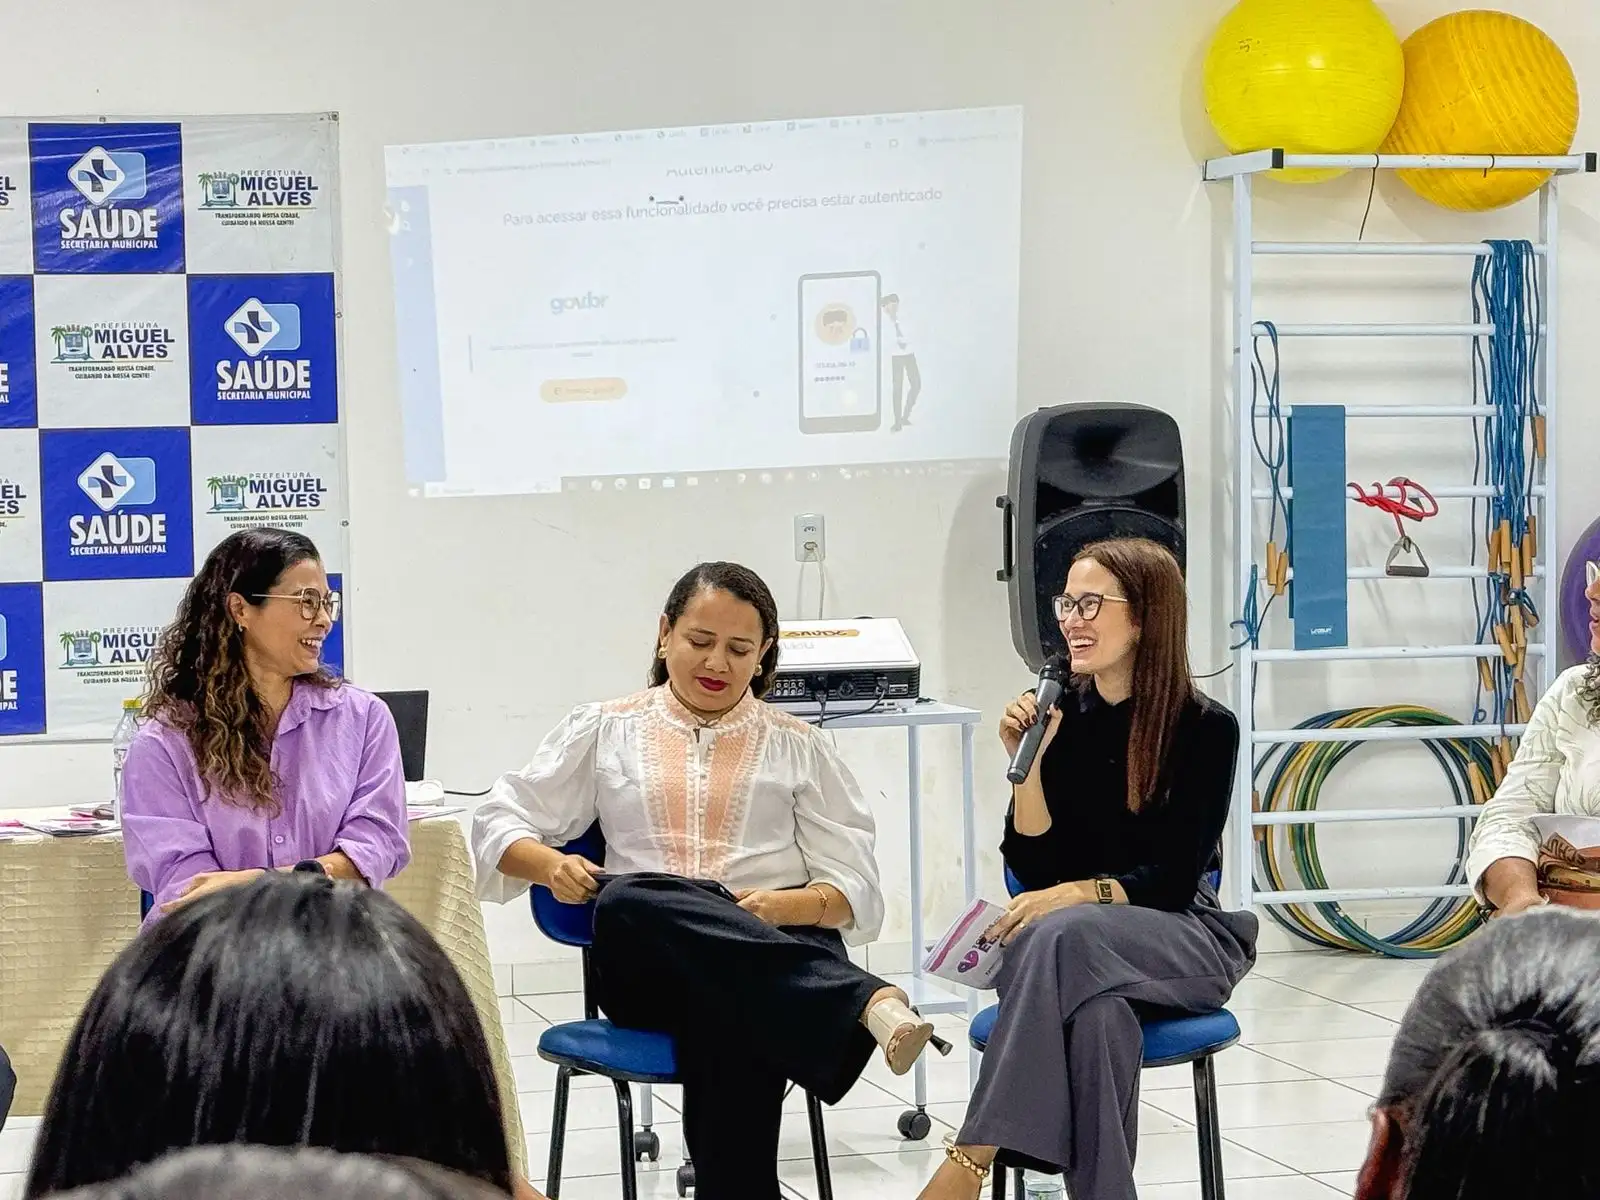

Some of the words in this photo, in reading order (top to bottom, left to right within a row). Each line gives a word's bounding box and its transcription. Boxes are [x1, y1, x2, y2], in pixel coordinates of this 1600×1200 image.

[240, 176, 318, 191] MIGUEL
[247, 192, 312, 206] ALVES
[503, 213, 533, 226] Para
[536, 210, 588, 223] acessar
[592, 207, 622, 221] essa
[626, 200, 728, 219] funcionalidade
[731, 198, 764, 213] você
[767, 193, 817, 212] precisa
[821, 193, 856, 207] estar
[859, 188, 943, 205] autenticado
[60, 203, 158, 239] SAÚDE
[61, 240, 110, 249] SECRETARIA
[112, 240, 158, 249] MUNICIPAL
[94, 329, 175, 343] MIGUEL
[102, 344, 168, 359] ALVES
[216, 355, 311, 390] SAÚDE
[217, 391, 264, 400] SECRETARIA
[266, 390, 311, 399] MUNICIPAL
[249, 478, 327, 493] MIGUEL
[256, 493, 320, 508] ALVES
[69, 509, 167, 545] SAÚDE
[70, 546, 119, 556] SECRETARIA
[120, 545, 167, 554] MUNICIPAL
[103, 633, 158, 648] MIGU
[110, 648, 155, 663] ALV
